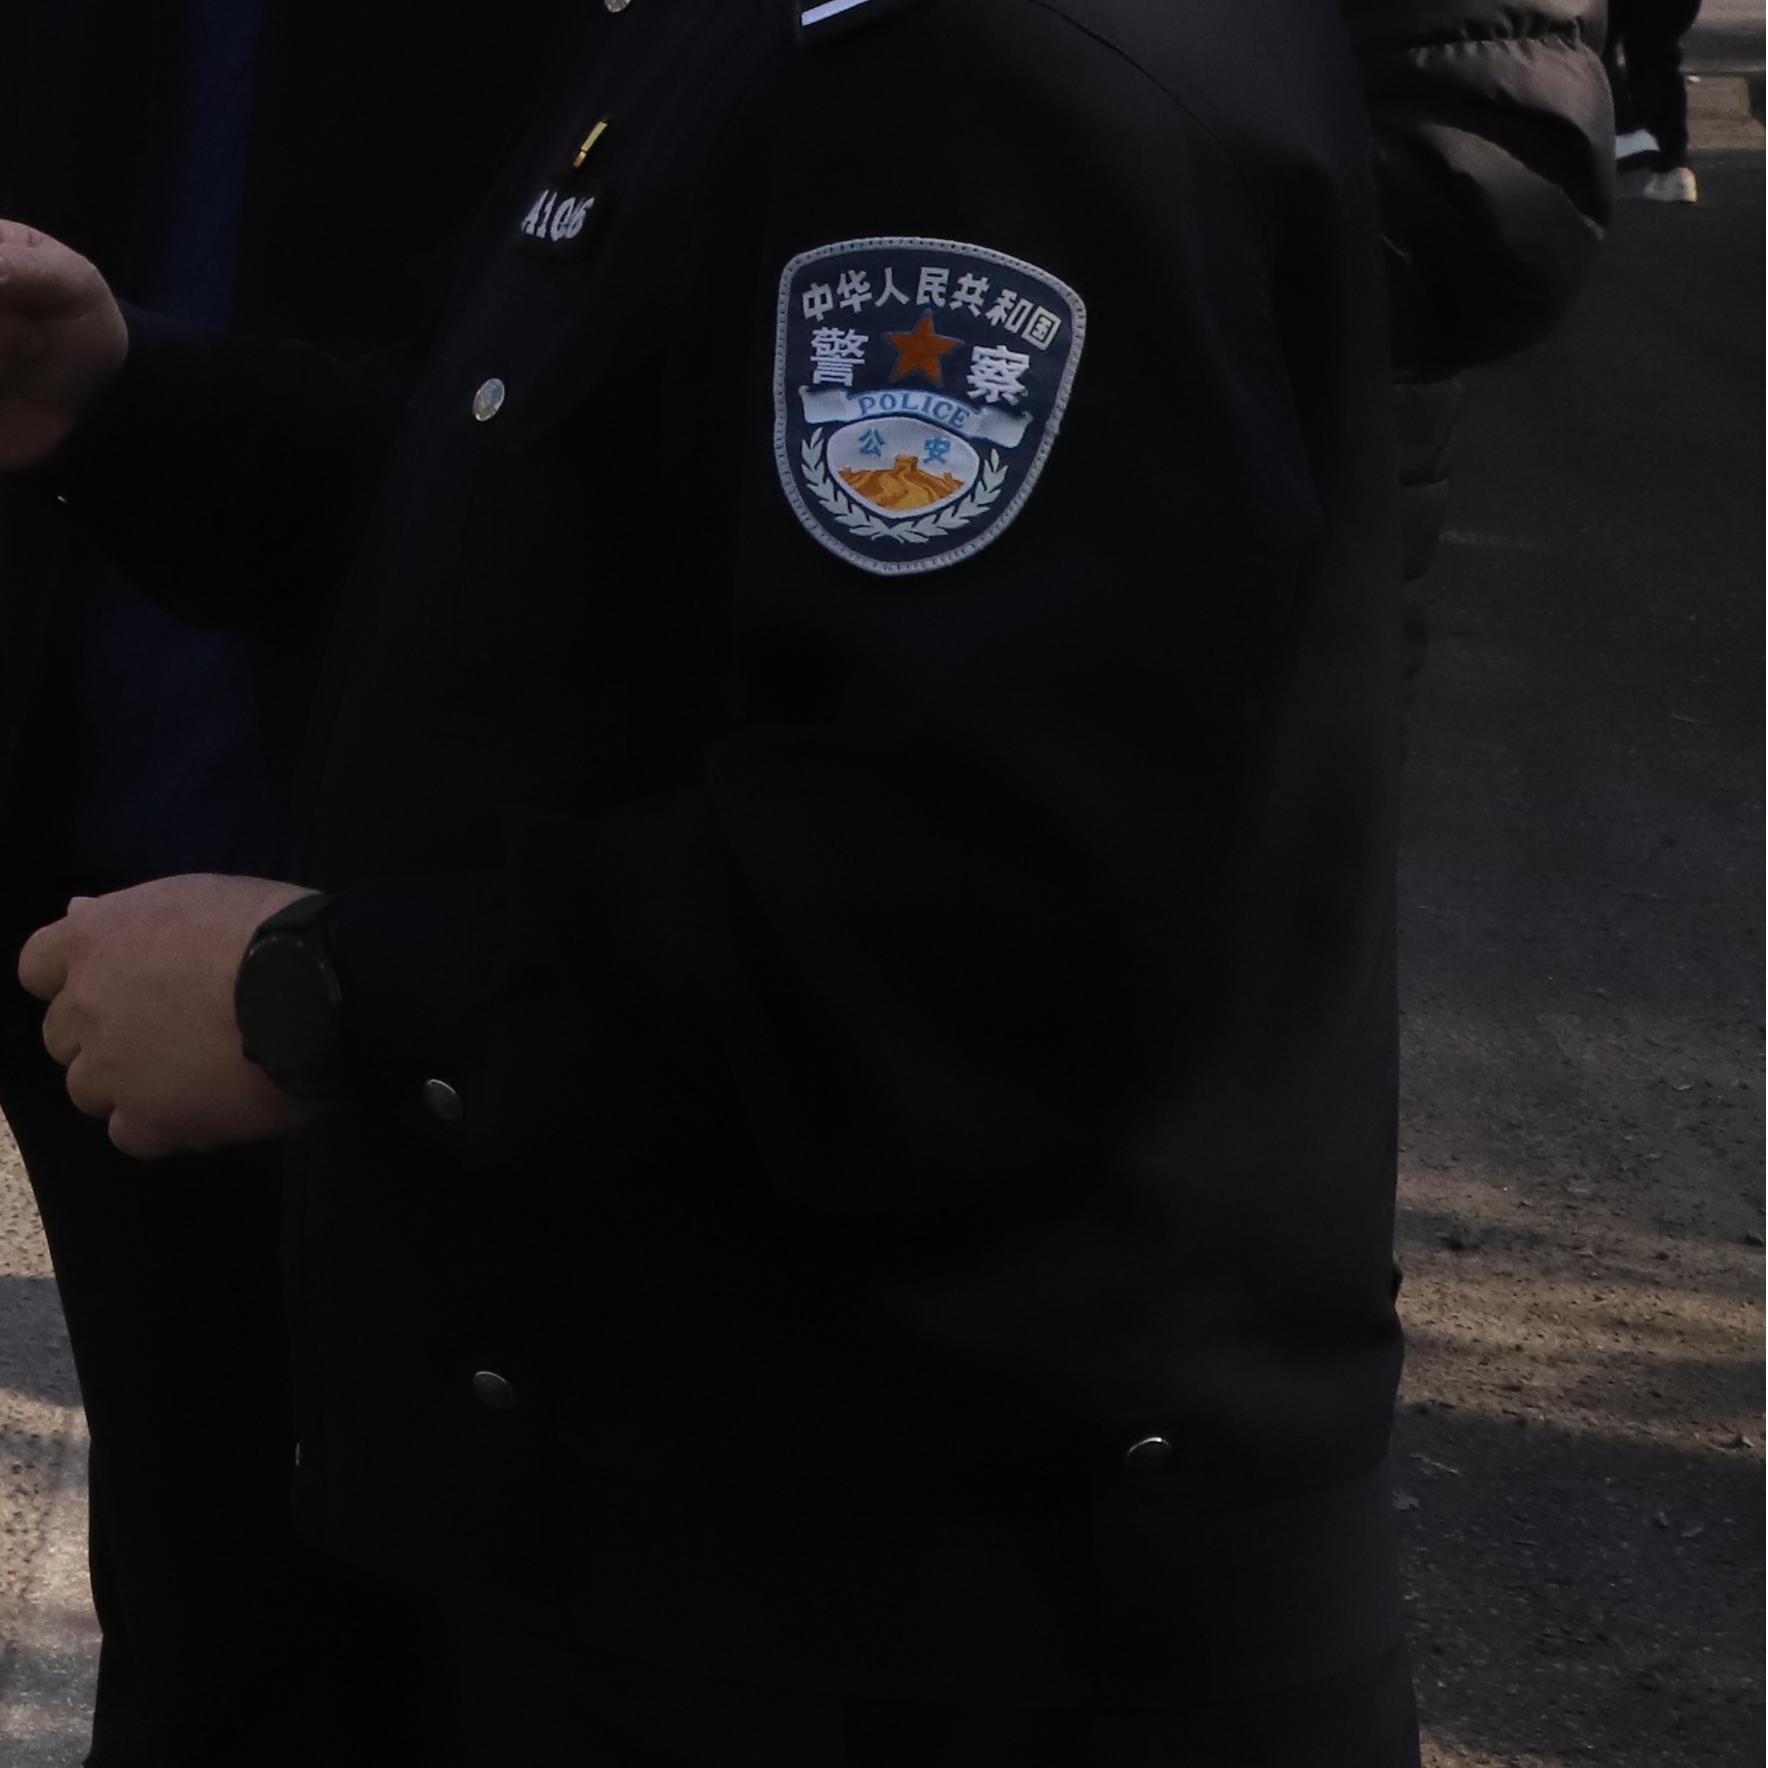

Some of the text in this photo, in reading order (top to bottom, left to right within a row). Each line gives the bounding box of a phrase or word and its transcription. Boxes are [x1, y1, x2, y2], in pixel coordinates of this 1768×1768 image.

[802, 267, 1063, 351] 中华人民共和国
[858, 393, 971, 429] POLICE
